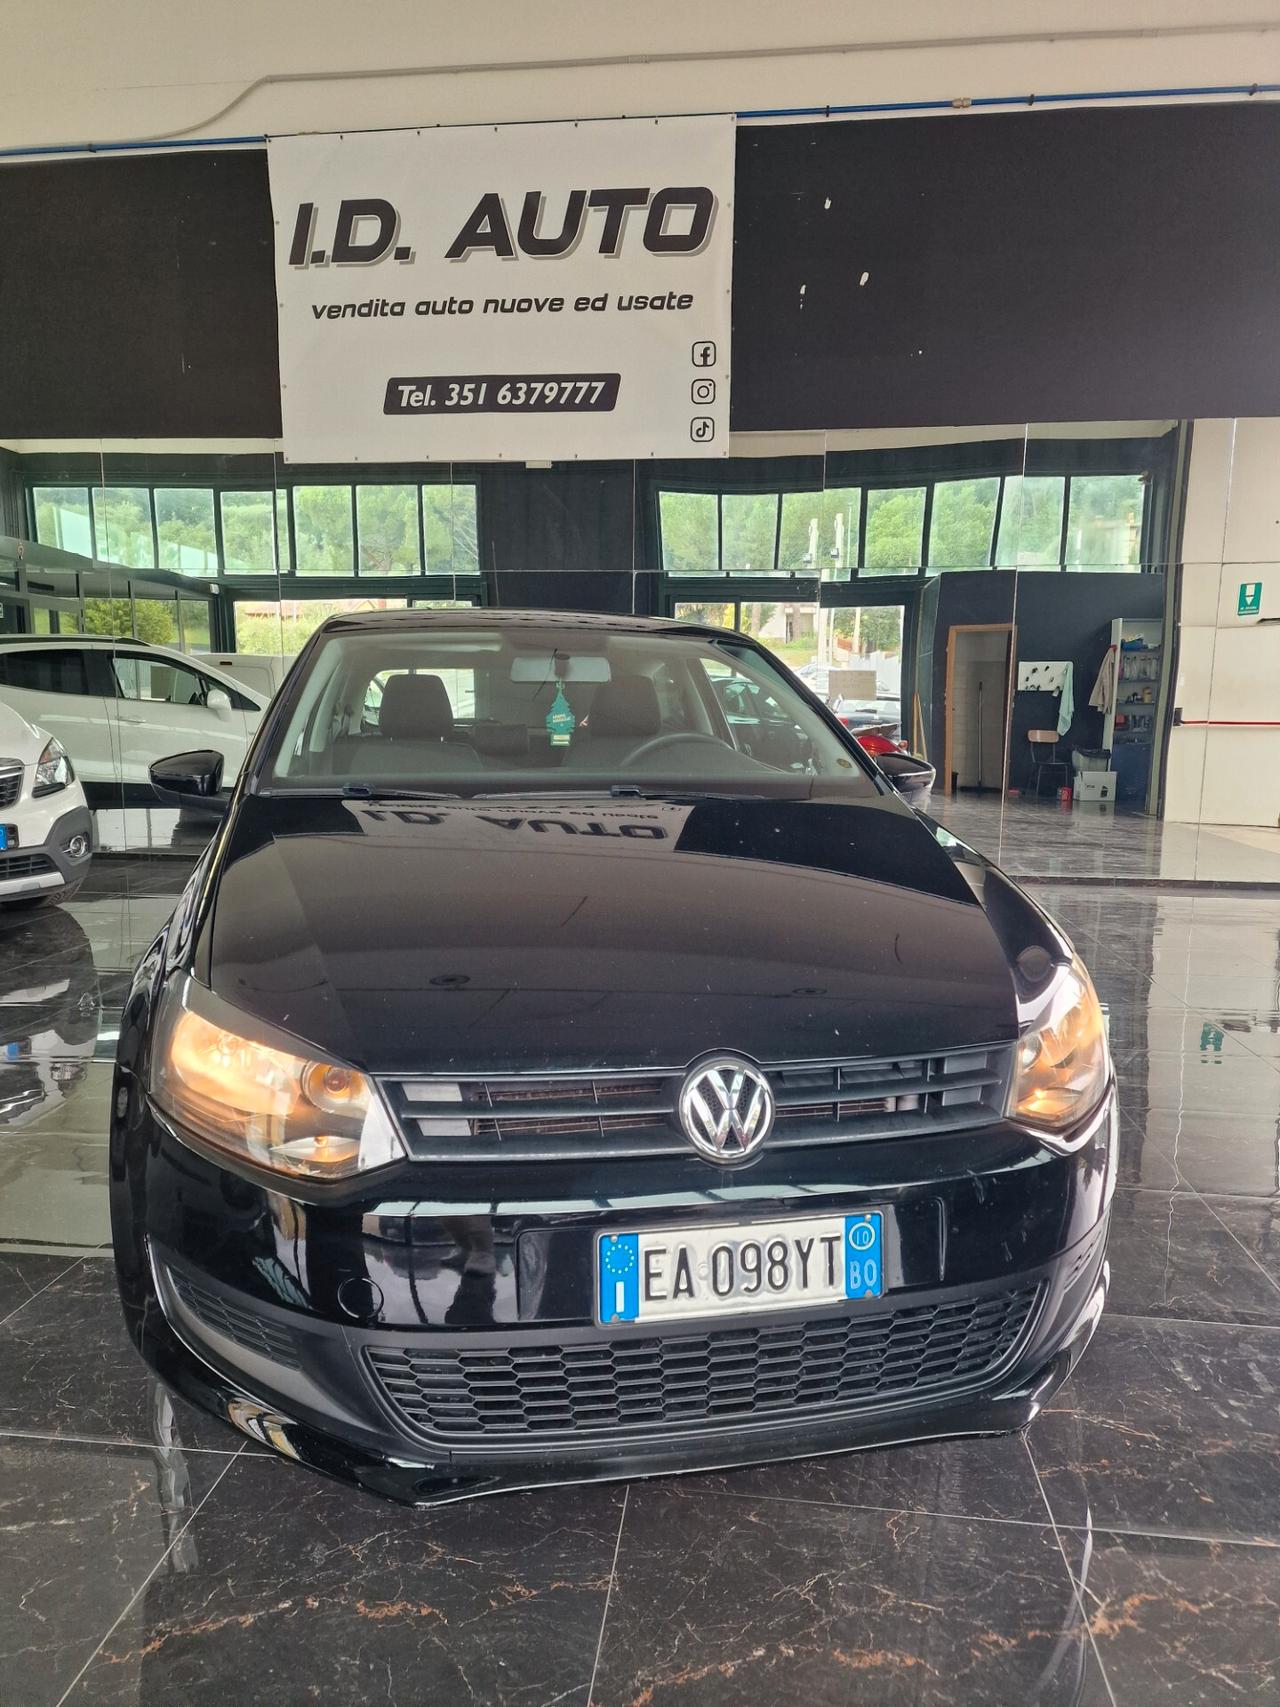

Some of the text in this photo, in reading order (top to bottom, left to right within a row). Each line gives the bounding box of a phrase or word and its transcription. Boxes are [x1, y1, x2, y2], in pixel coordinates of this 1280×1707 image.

[289, 186, 720, 269] I.D. AUTO
[311, 291, 694, 320] vendita auto nuove ed usate
[397, 381, 606, 408] Tel. 351 6379777
[644, 1234, 841, 1301] EA 098YT
[849, 1259, 877, 1290] BO
